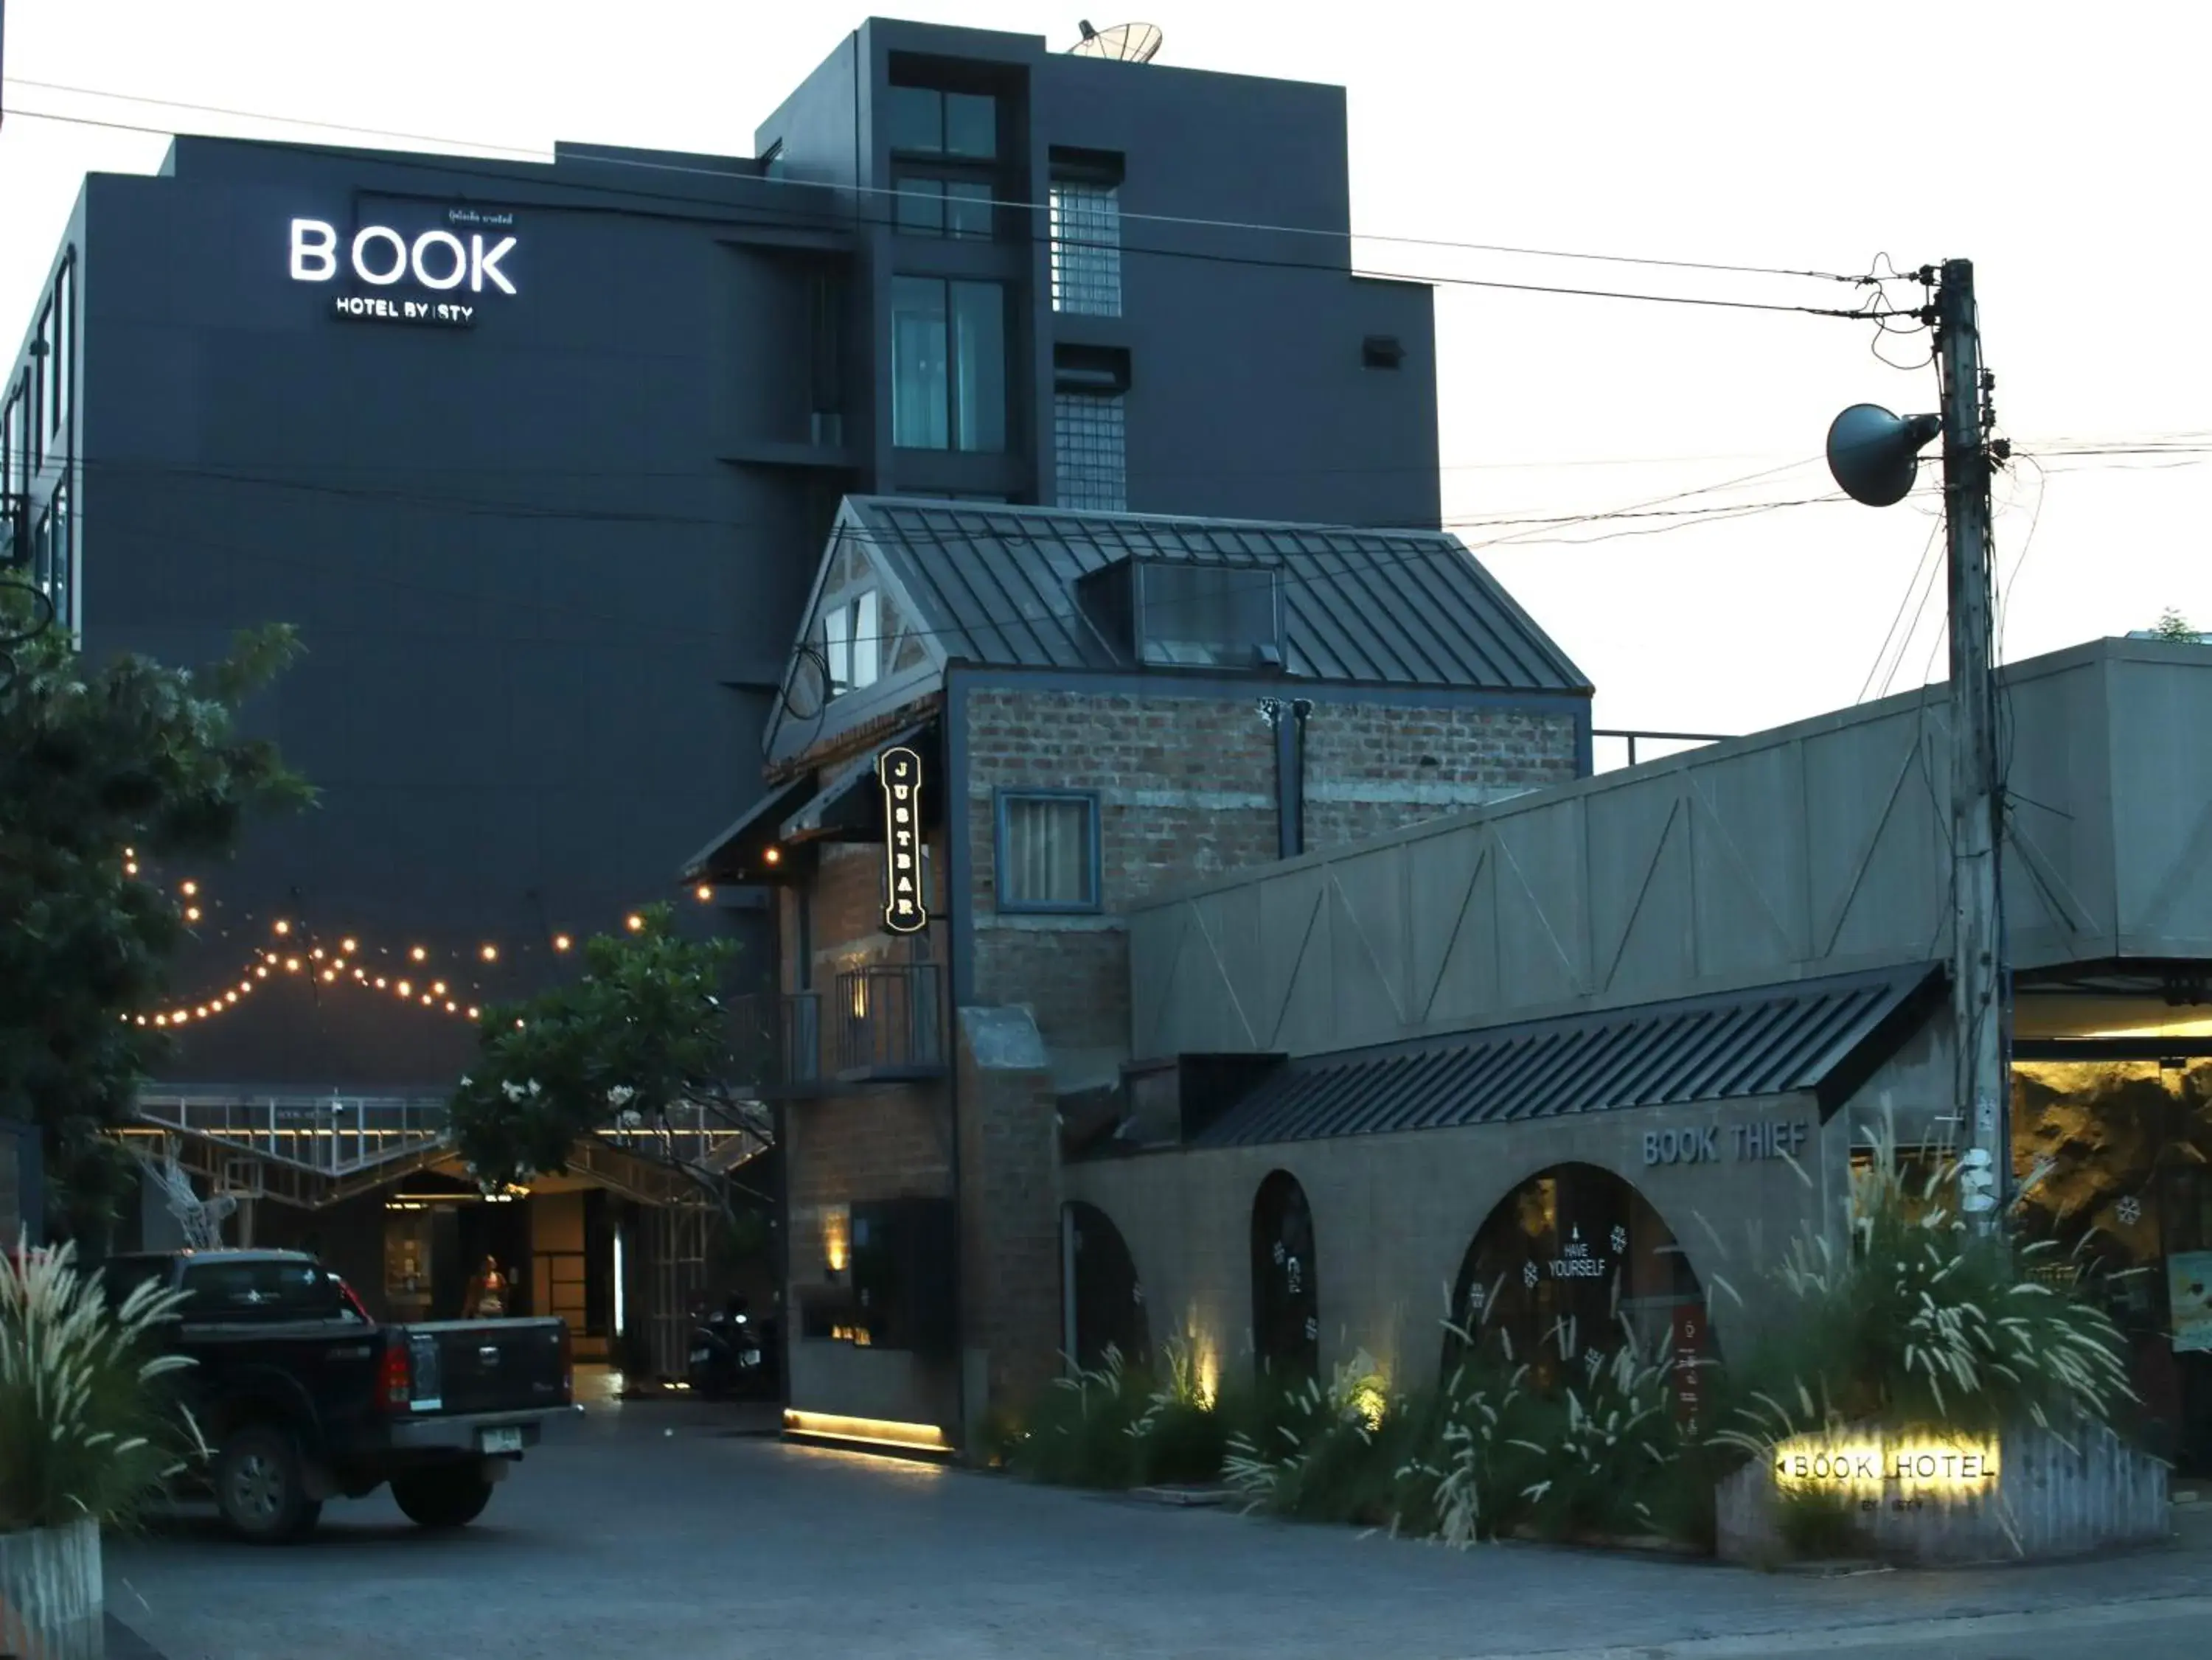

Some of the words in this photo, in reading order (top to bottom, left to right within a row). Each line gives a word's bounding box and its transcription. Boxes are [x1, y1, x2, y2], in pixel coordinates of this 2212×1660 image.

[291, 219, 517, 294] BOOK
[337, 297, 399, 317] HOTEL
[404, 302, 428, 318] BY
[437, 304, 473, 321] STY
[1644, 1126, 1719, 1166] BOOK
[1731, 1121, 1808, 1160] THIEF
[1549, 1259, 1605, 1277] YOURSELF
[1795, 1456, 1874, 1478] BOOK
[1896, 1455, 1995, 1479] HOTEL
